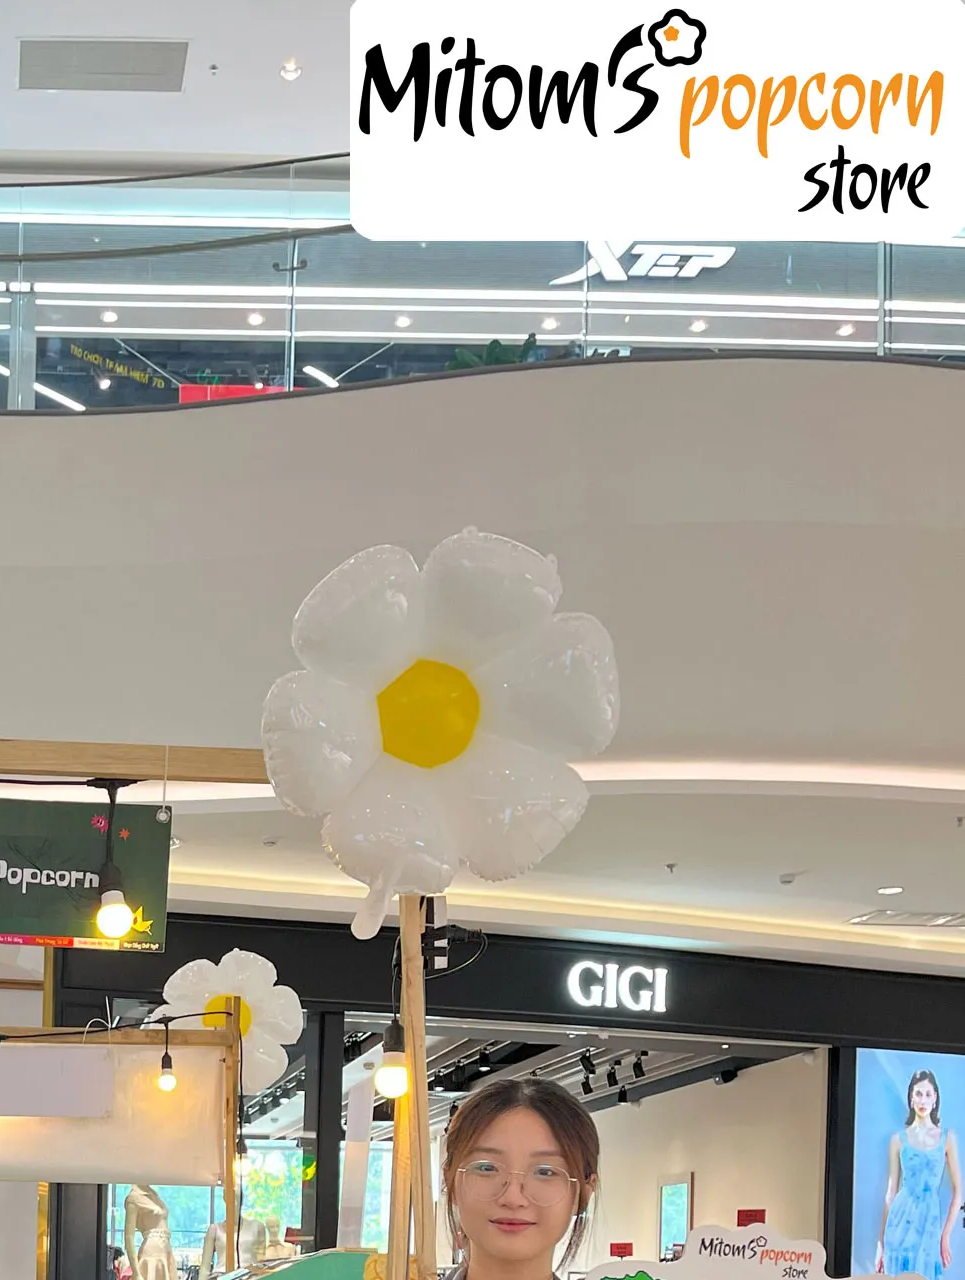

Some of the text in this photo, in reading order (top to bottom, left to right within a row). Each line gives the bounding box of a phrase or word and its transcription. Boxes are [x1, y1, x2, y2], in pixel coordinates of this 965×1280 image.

[567, 961, 668, 1012] GIGI
[759, 1249, 812, 1266] popcorn
[782, 1265, 809, 1280] store
